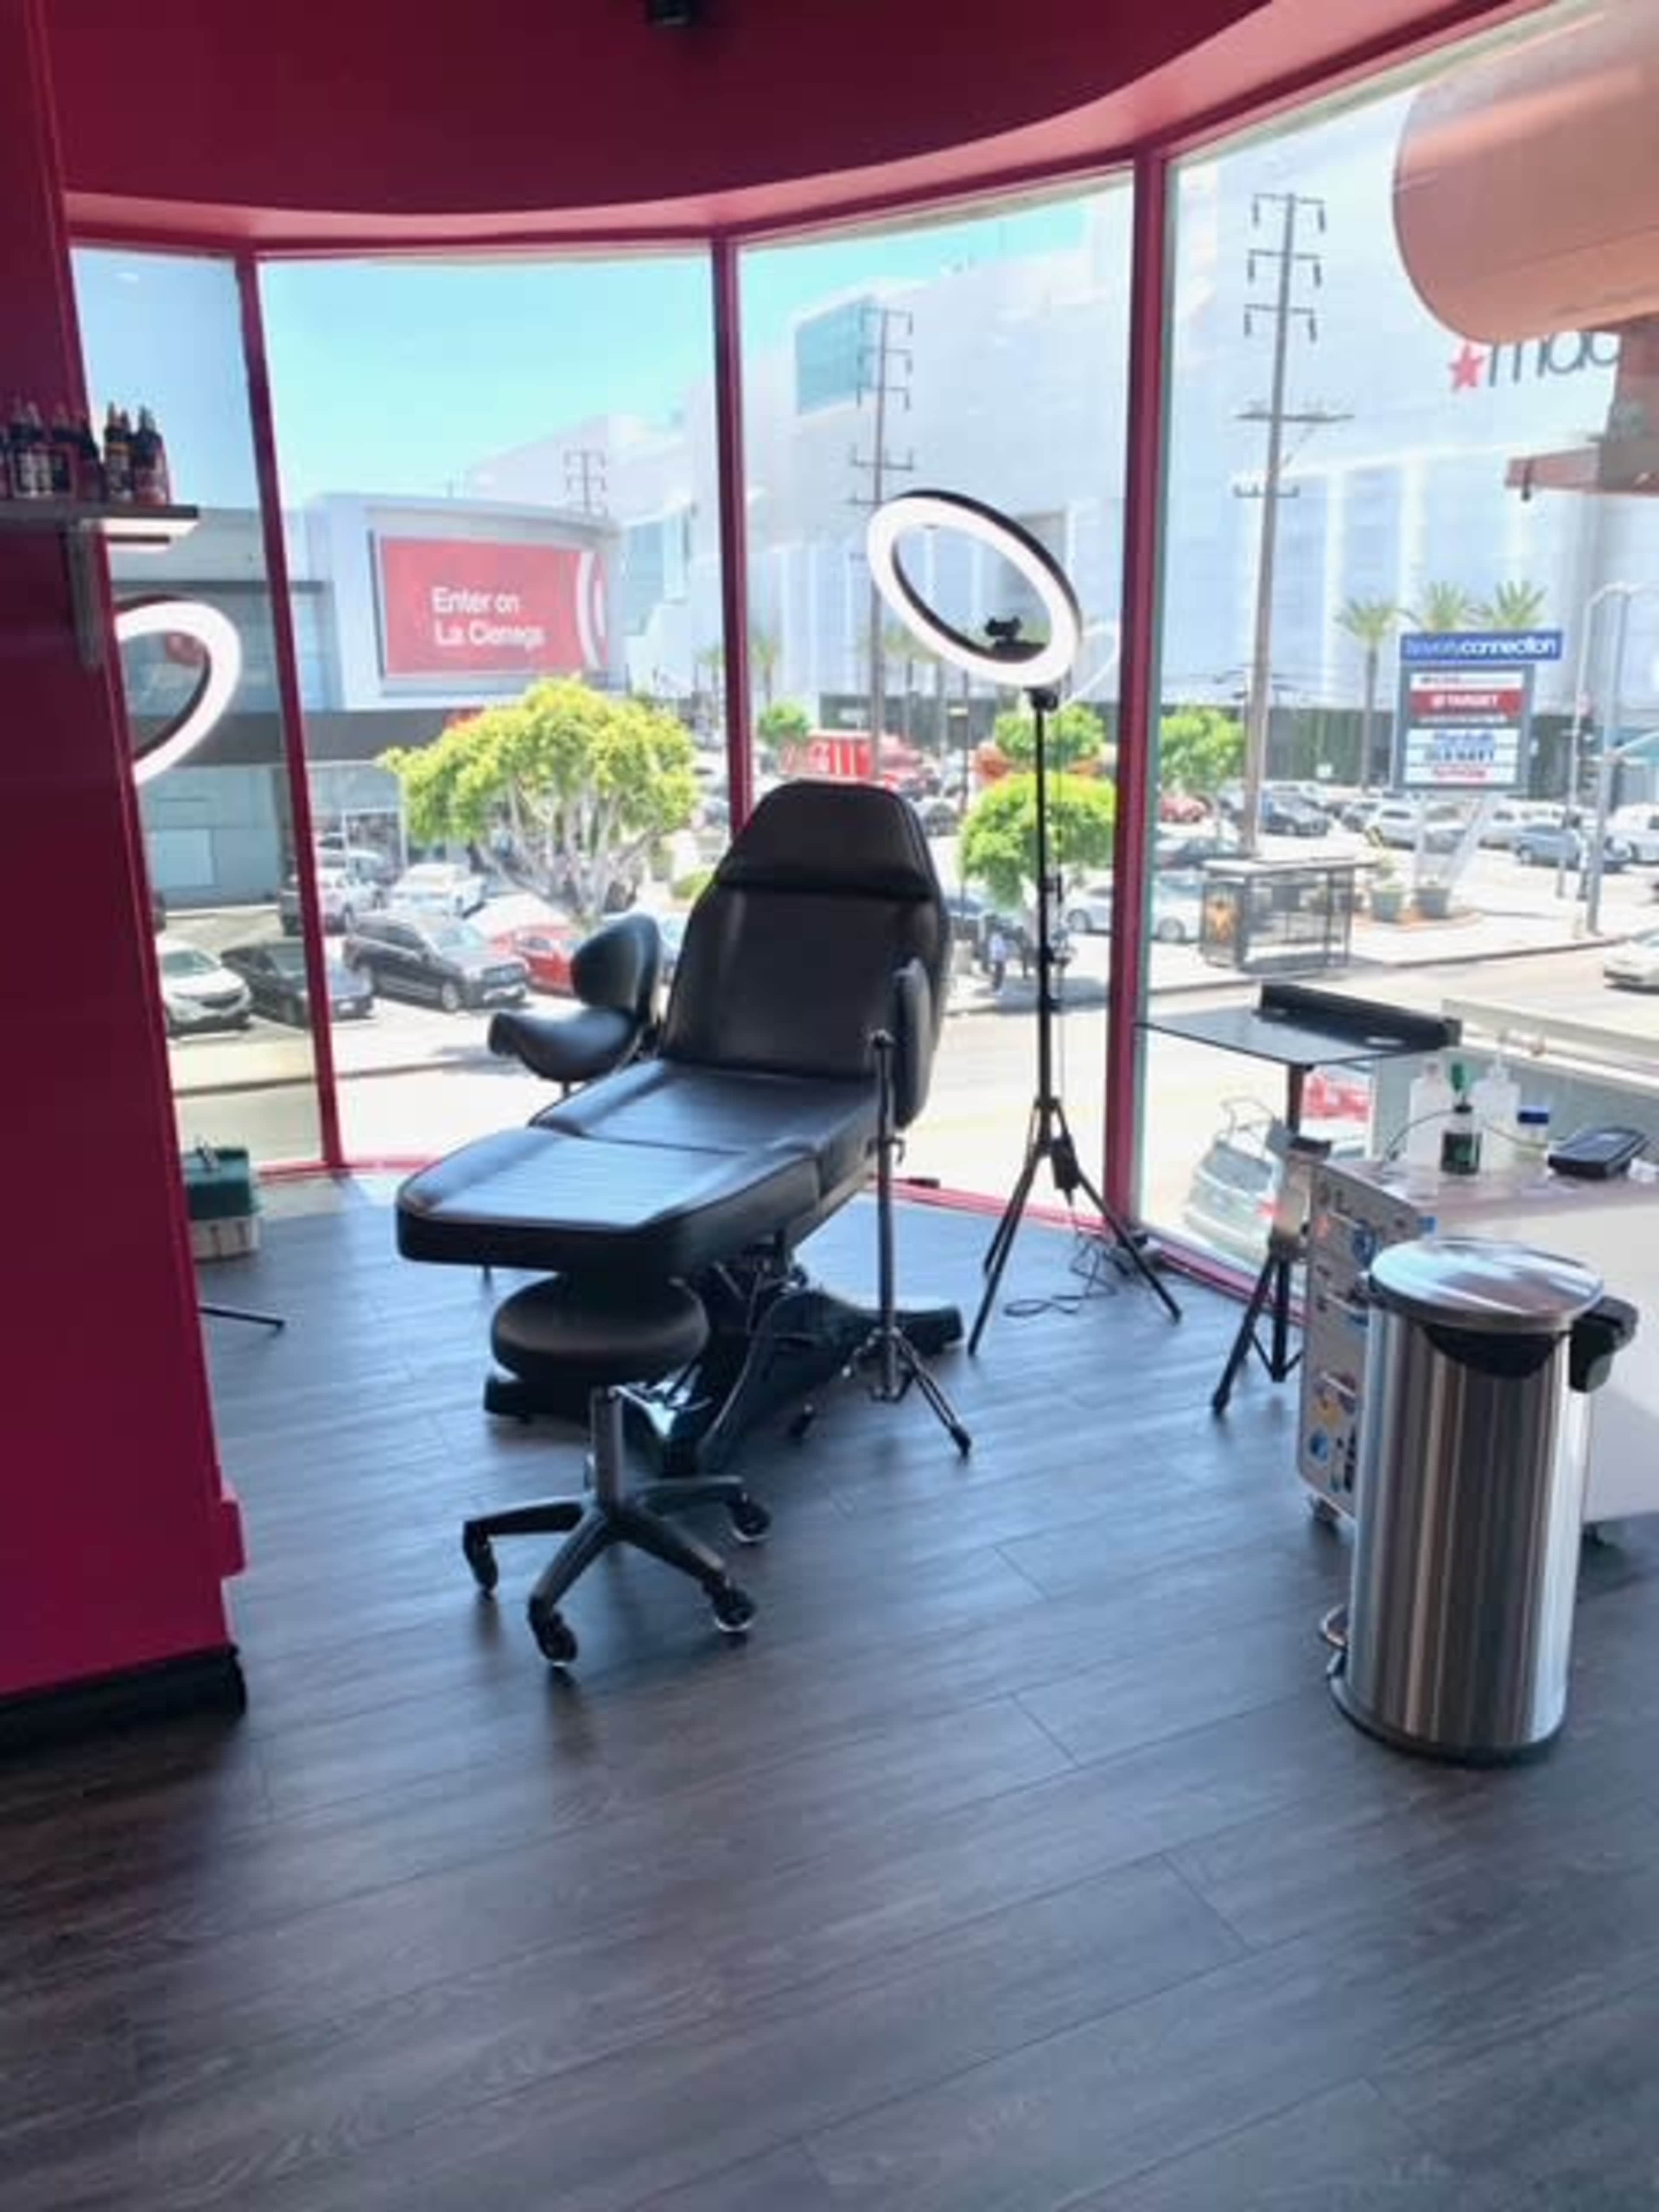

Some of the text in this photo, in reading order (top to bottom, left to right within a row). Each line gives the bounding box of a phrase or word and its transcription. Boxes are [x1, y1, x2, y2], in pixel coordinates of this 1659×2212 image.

[432, 586, 519, 613] Enter on
[434, 620, 465, 646] La
